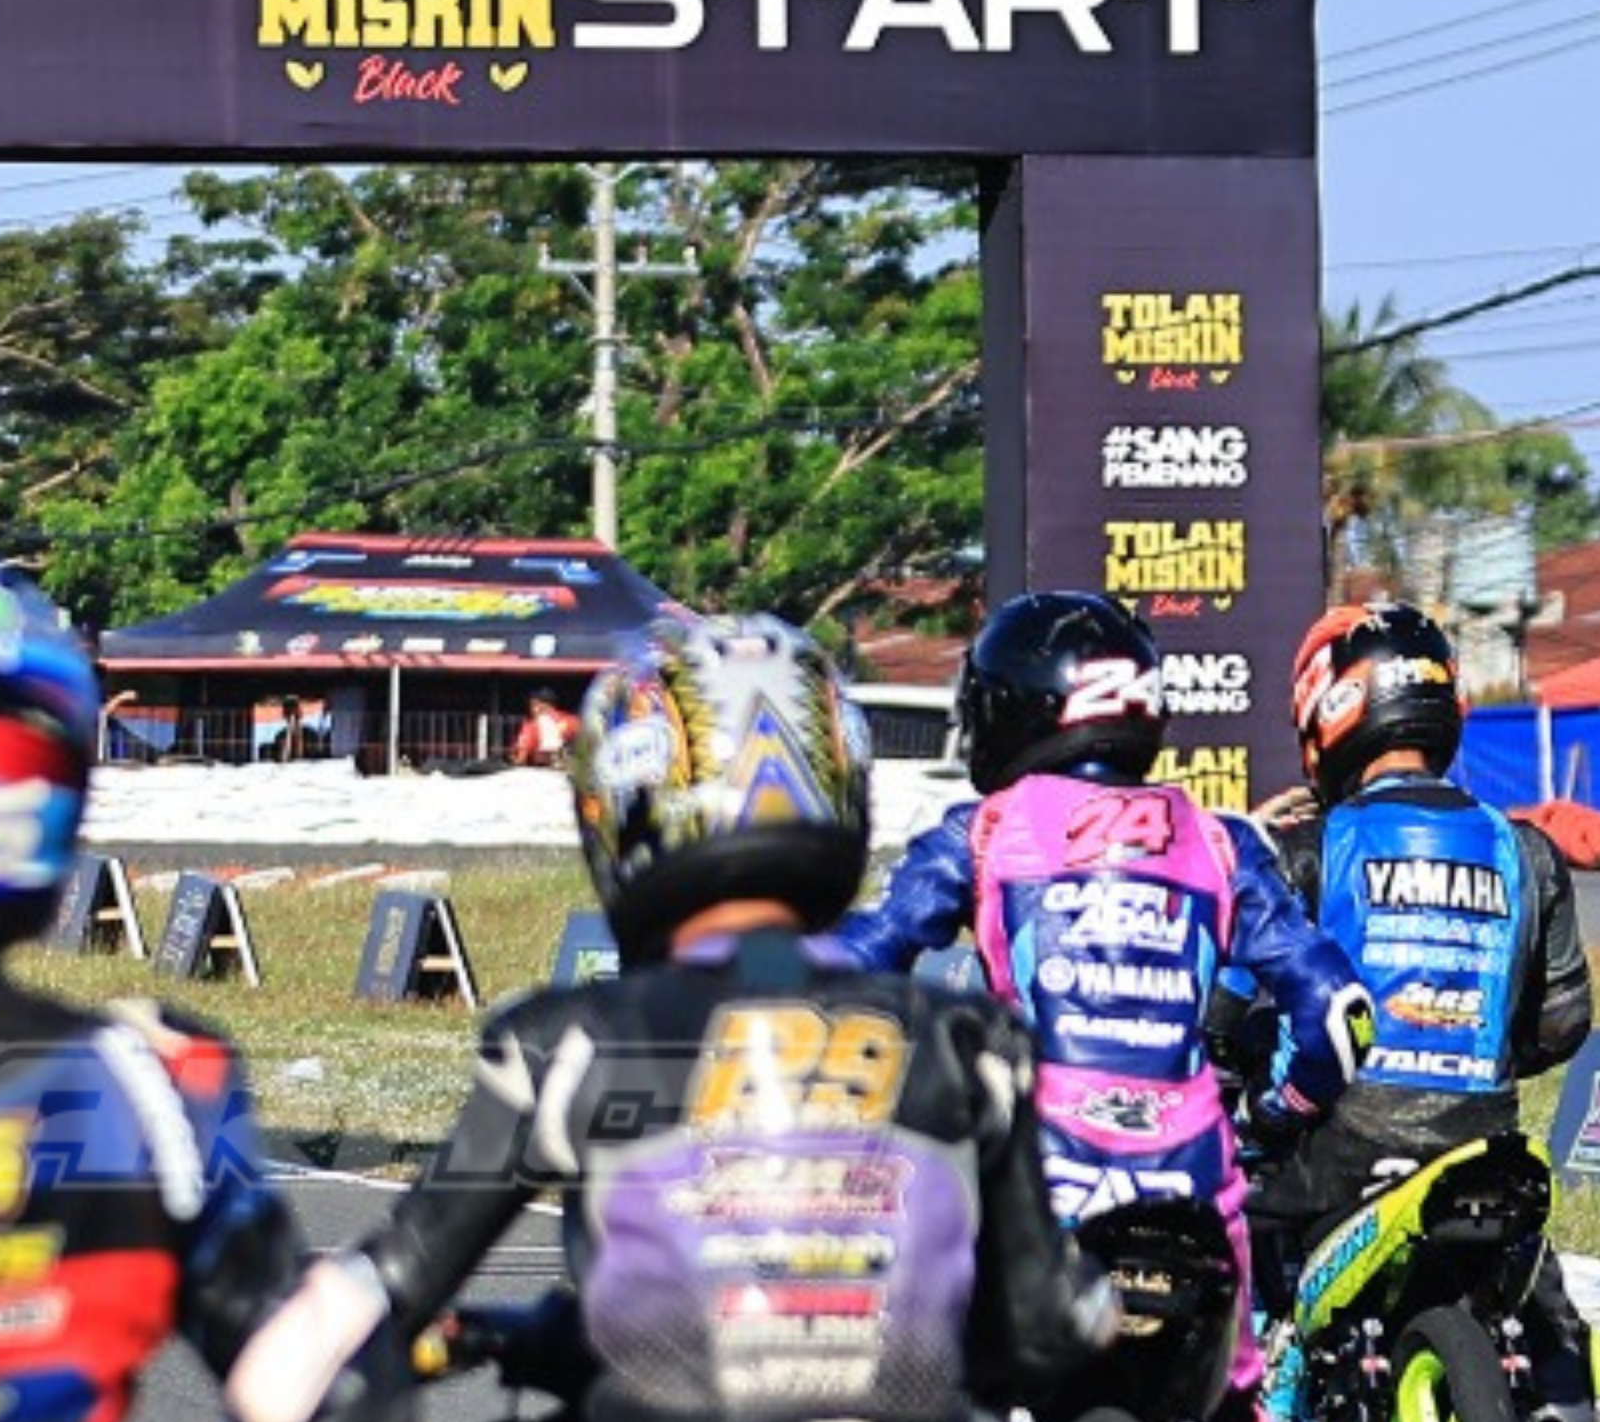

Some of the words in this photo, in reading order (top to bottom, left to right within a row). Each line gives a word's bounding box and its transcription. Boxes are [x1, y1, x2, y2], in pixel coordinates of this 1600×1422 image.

[352, 54, 465, 103] Black
[1102, 293, 1243, 327] TOLAK
[1102, 320, 1243, 365] MISKIN
[1102, 426, 1247, 463] #SANG
[1104, 520, 1245, 557] TOLAK
[1104, 547, 1245, 593] MISKIN
[1064, 793, 1175, 867] 24
[1364, 858, 1510, 917] YAMAHA
[1076, 960, 1195, 1004] YAMAHA
[1365, 1046, 1498, 1078] TAICHI
